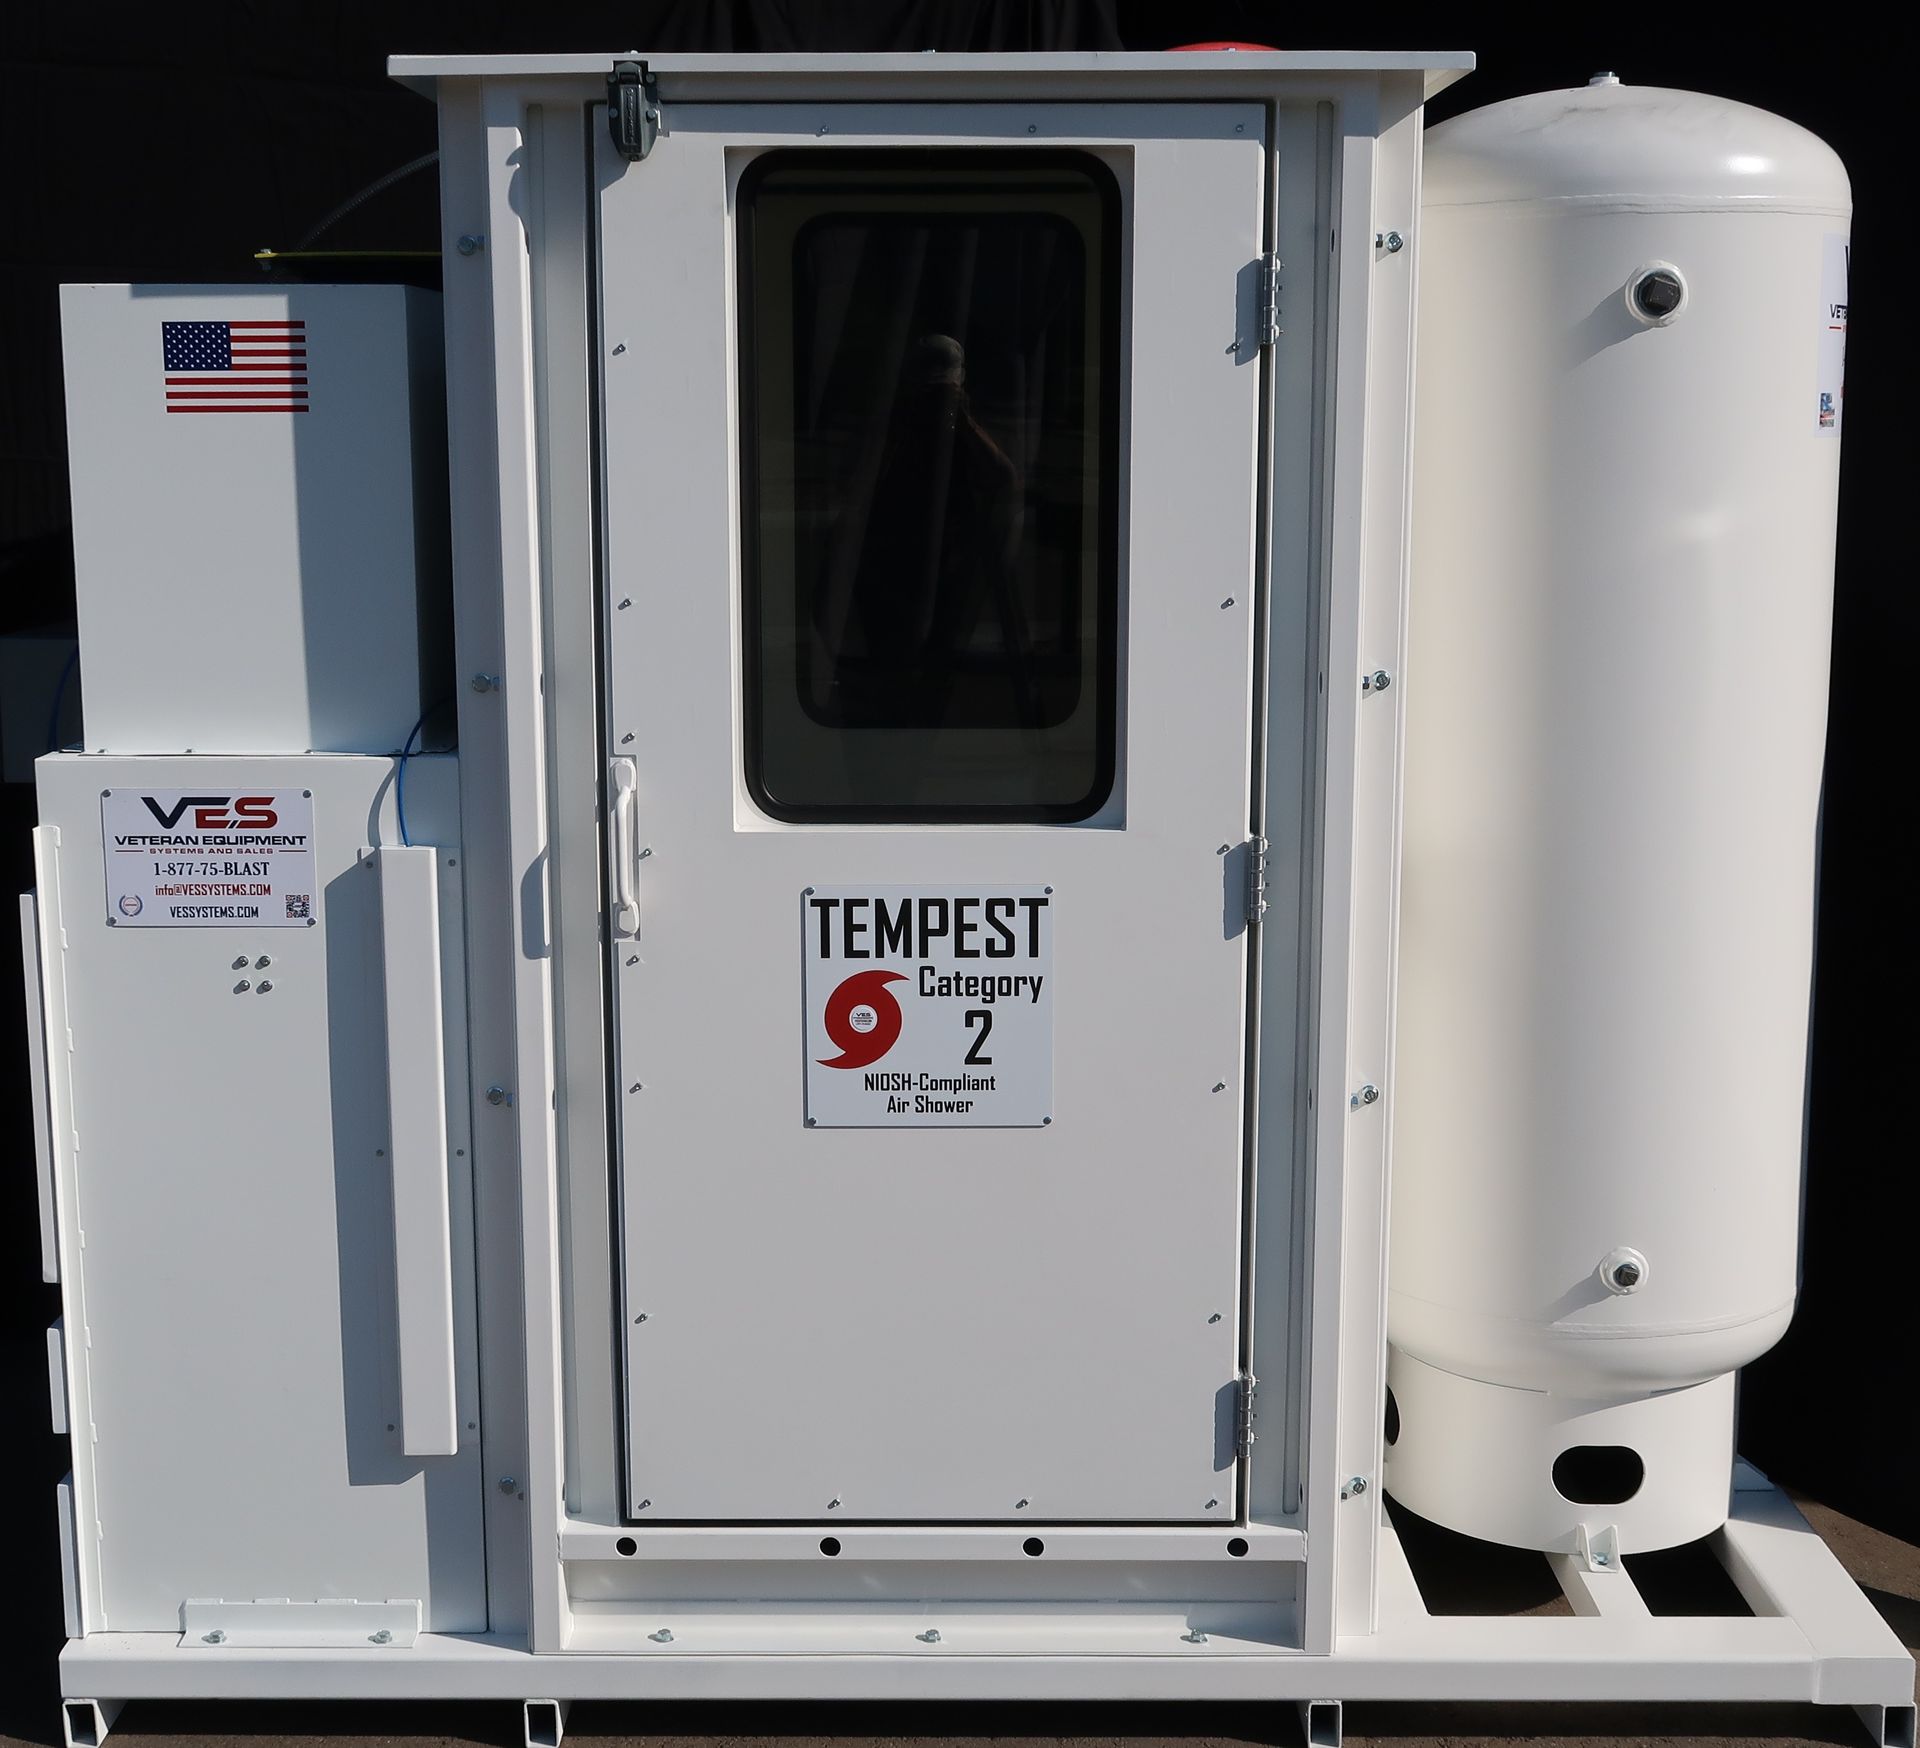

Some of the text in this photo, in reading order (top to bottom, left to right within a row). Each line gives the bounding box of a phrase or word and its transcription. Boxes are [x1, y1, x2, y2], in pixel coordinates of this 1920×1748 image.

[140, 796, 279, 830] VES
[114, 835, 307, 846] VETERAN EQUIPMENT
[153, 862, 270, 876] 1-877-75-BLAST
[154, 884, 271, 896] info@VESSYSTEMS.COM
[169, 906, 259, 919] VESSYSTEMS.COM
[809, 897, 1049, 959] TEMPEST
[918, 965, 1044, 1004] Category
[963, 1009, 993, 1065] 2
[864, 1073, 996, 1094] NIOSH-Compliant
[886, 1096, 974, 1114] Air Shower
